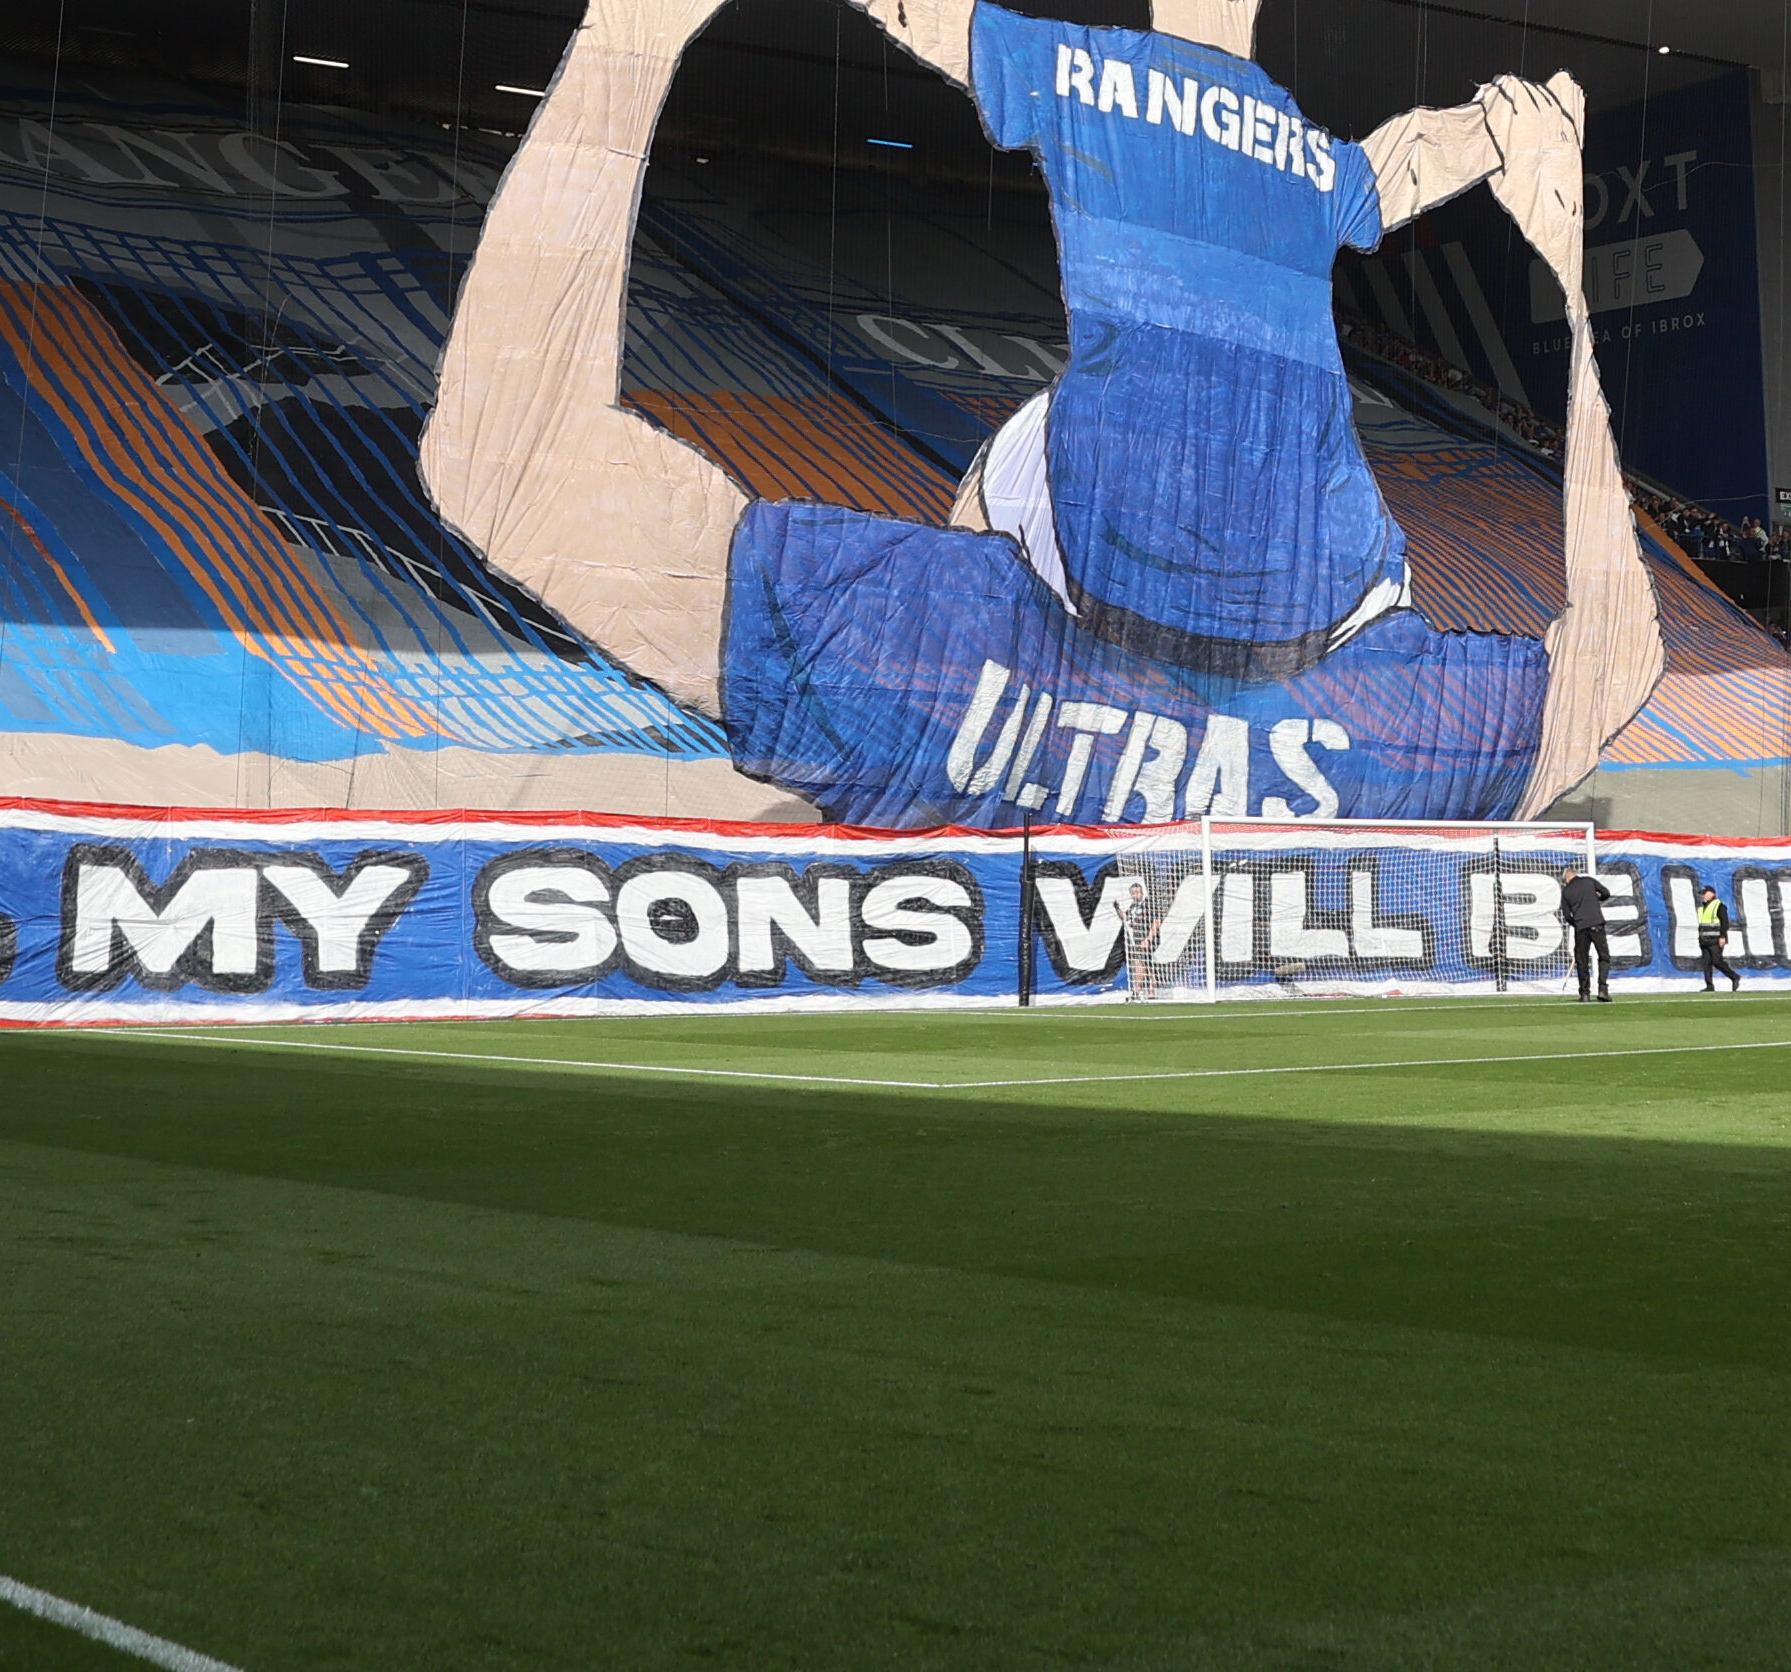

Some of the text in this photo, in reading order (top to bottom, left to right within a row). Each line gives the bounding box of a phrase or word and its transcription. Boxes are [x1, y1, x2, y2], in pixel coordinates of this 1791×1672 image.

[1056, 44, 1336, 192] RANGERS
[1591, 244, 1666, 304] IFE
[1621, 323, 1642, 339] OF
[1652, 312, 1706, 333] IBROX
[946, 658, 1350, 824] ULTRAS
[65, 855, 422, 984] MY
[480, 856, 978, 984] SONS
[1032, 863, 1427, 978] WILL
